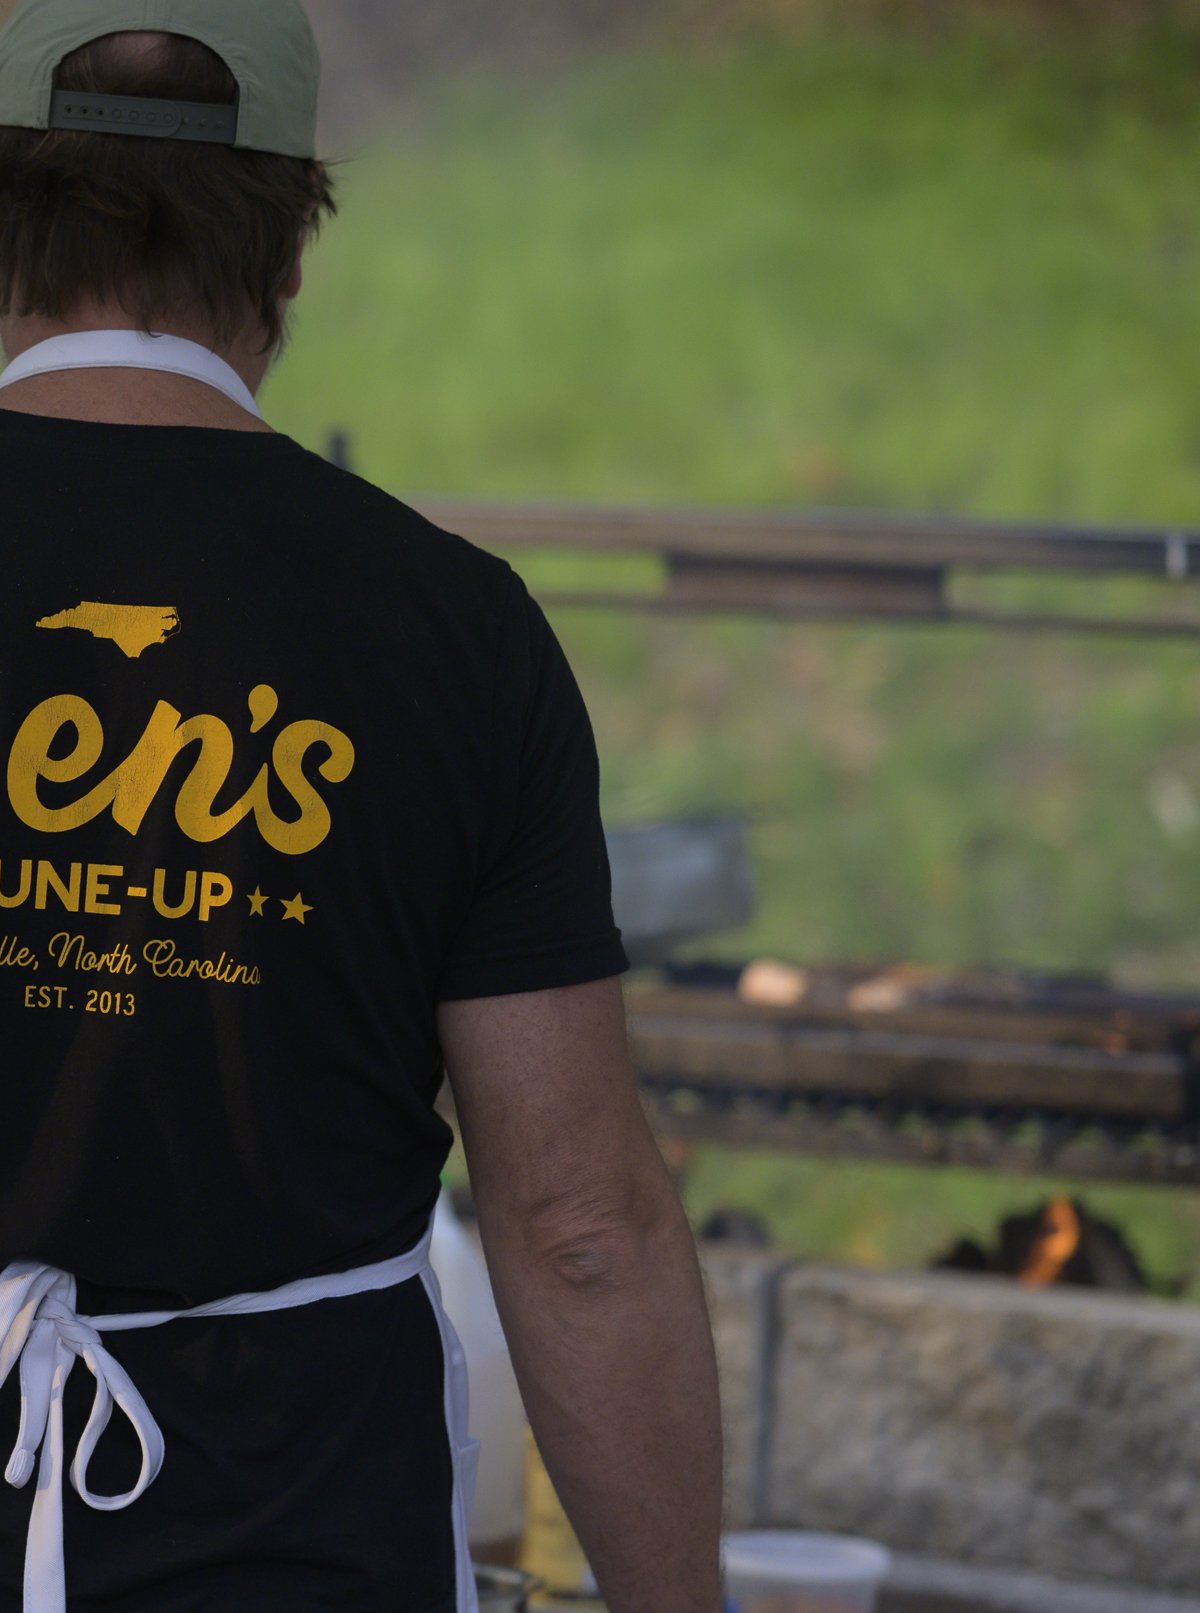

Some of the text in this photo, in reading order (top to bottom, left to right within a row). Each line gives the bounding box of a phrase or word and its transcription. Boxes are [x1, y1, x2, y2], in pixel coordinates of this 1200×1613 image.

[48, 932, 138, 976] North
[142, 938, 261, 985] Carolina
[24, 985, 136, 1017] EST. 2013
